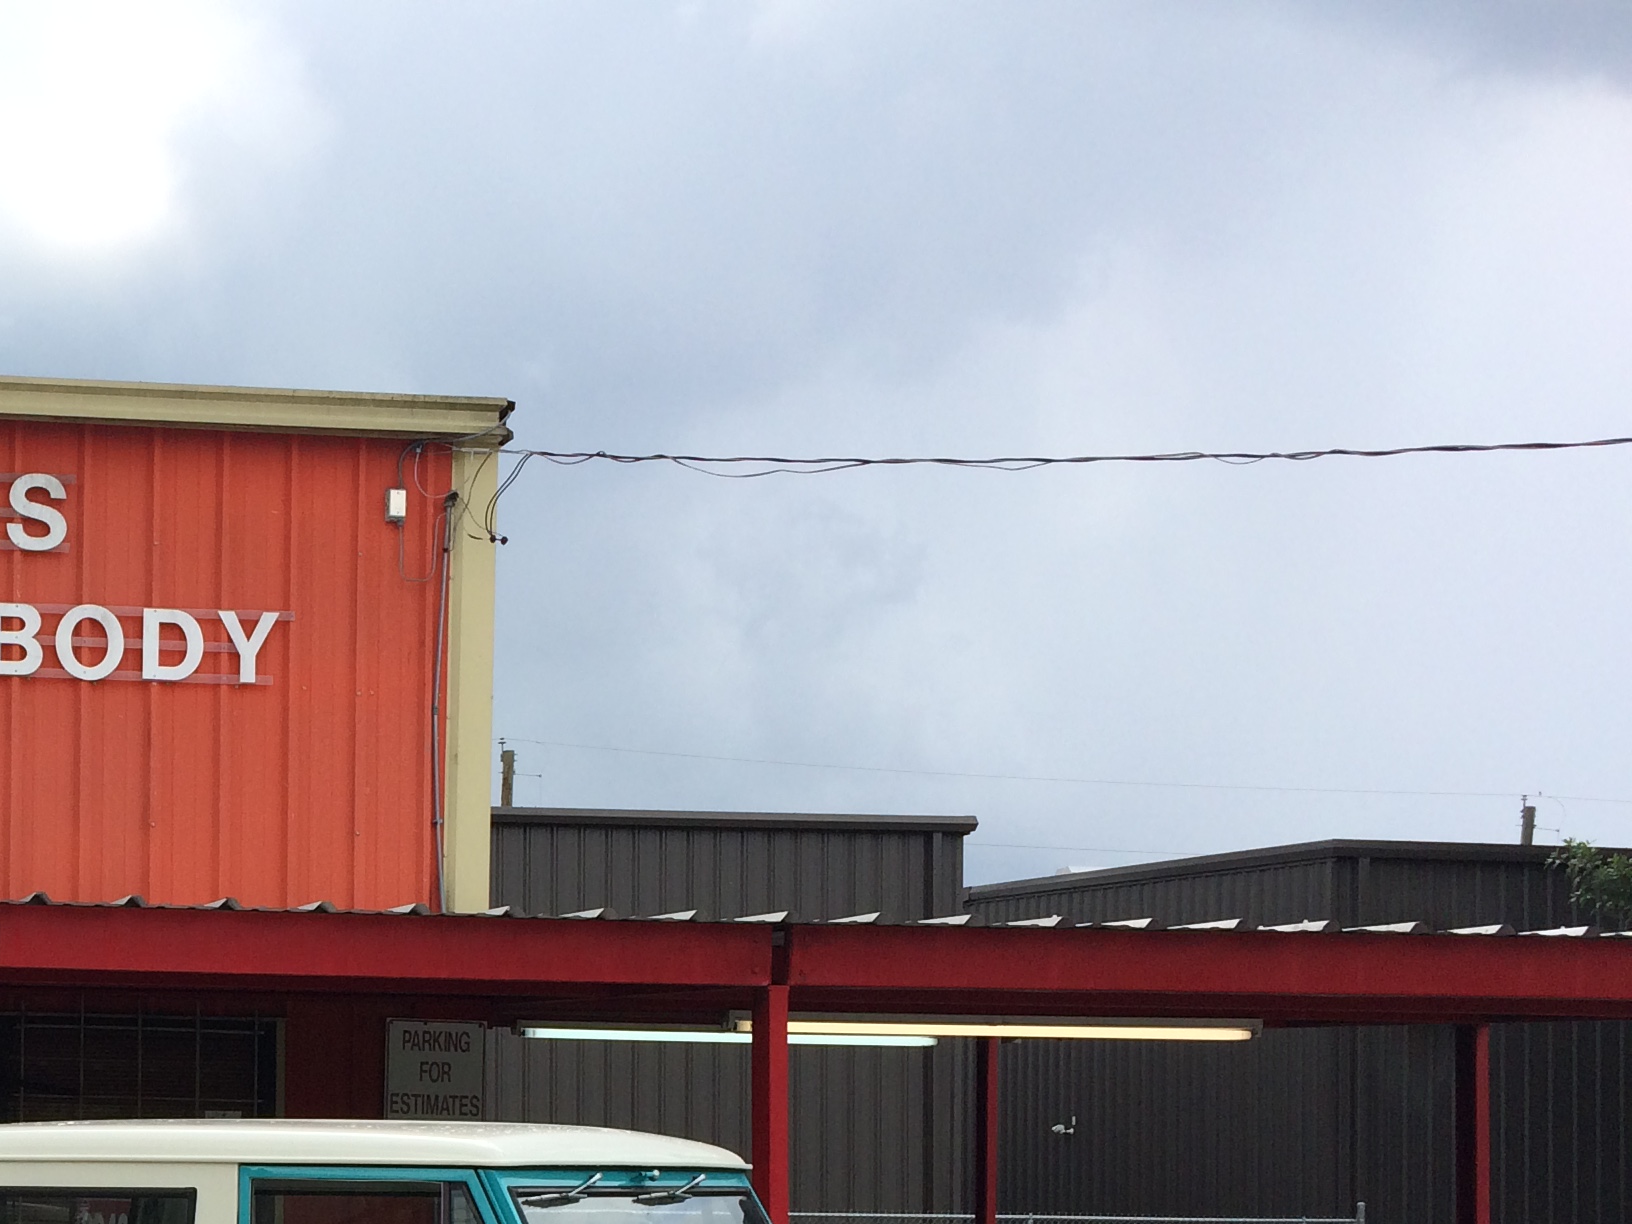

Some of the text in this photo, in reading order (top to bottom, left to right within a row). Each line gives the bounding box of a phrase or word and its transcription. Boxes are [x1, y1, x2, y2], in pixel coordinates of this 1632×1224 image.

[402, 1029, 471, 1053] PARKING
[419, 1061, 452, 1083] FOR
[389, 1092, 481, 1117] ESTIMATES
